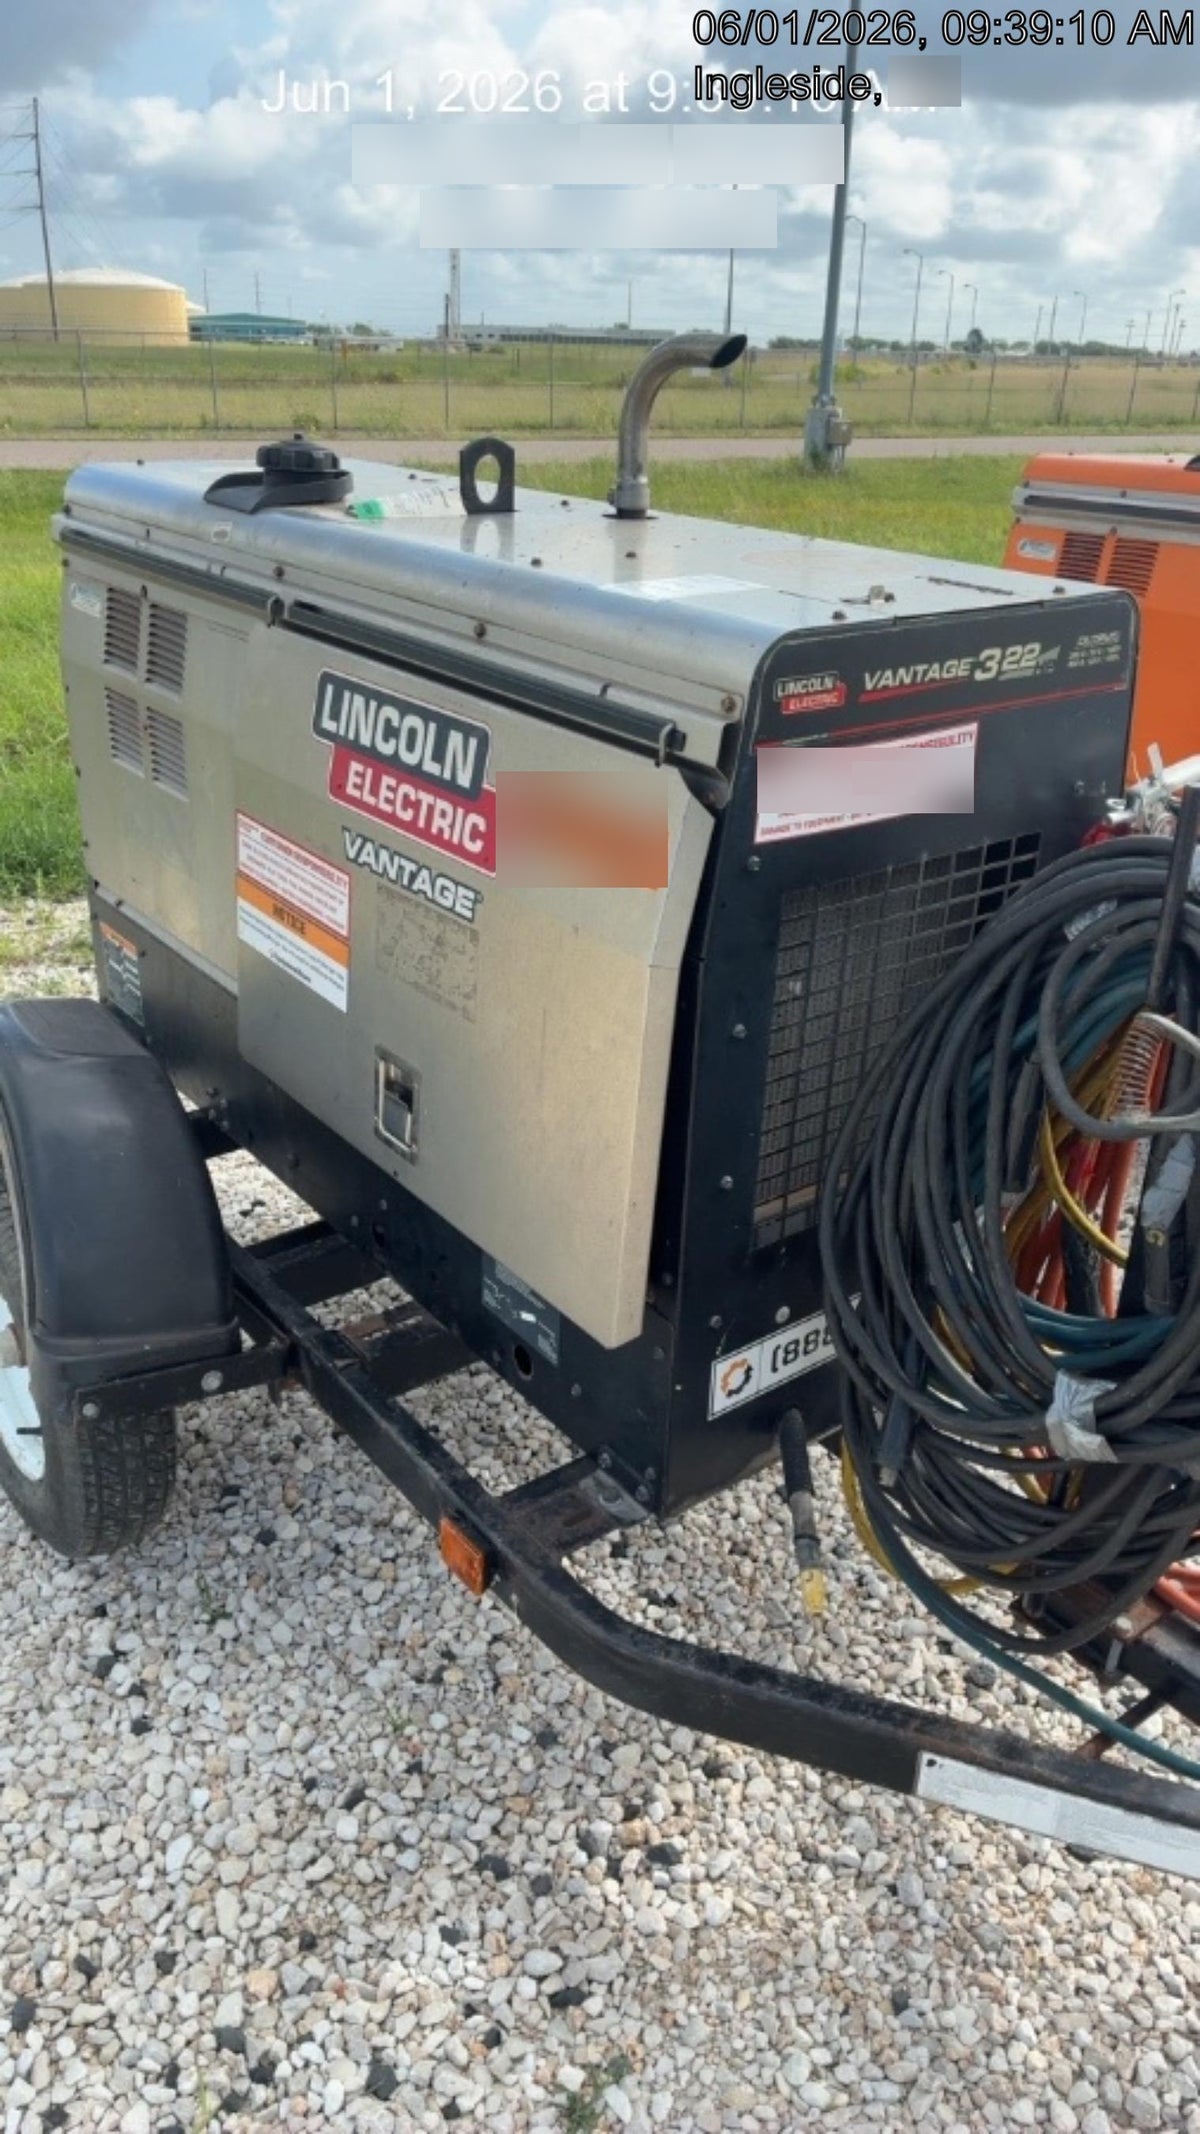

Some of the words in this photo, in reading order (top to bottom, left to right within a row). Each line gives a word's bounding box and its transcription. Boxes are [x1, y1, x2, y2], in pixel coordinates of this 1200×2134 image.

[777, 675, 835, 697] LINCOLN
[863, 655, 977, 691] VANTAGE
[974, 641, 1043, 682] 322
[320, 683, 479, 789] LINCOLN
[344, 760, 488, 854] ELECTRIC
[342, 826, 478, 922] VANTAGE
[272, 901, 306, 936] NOTICE
